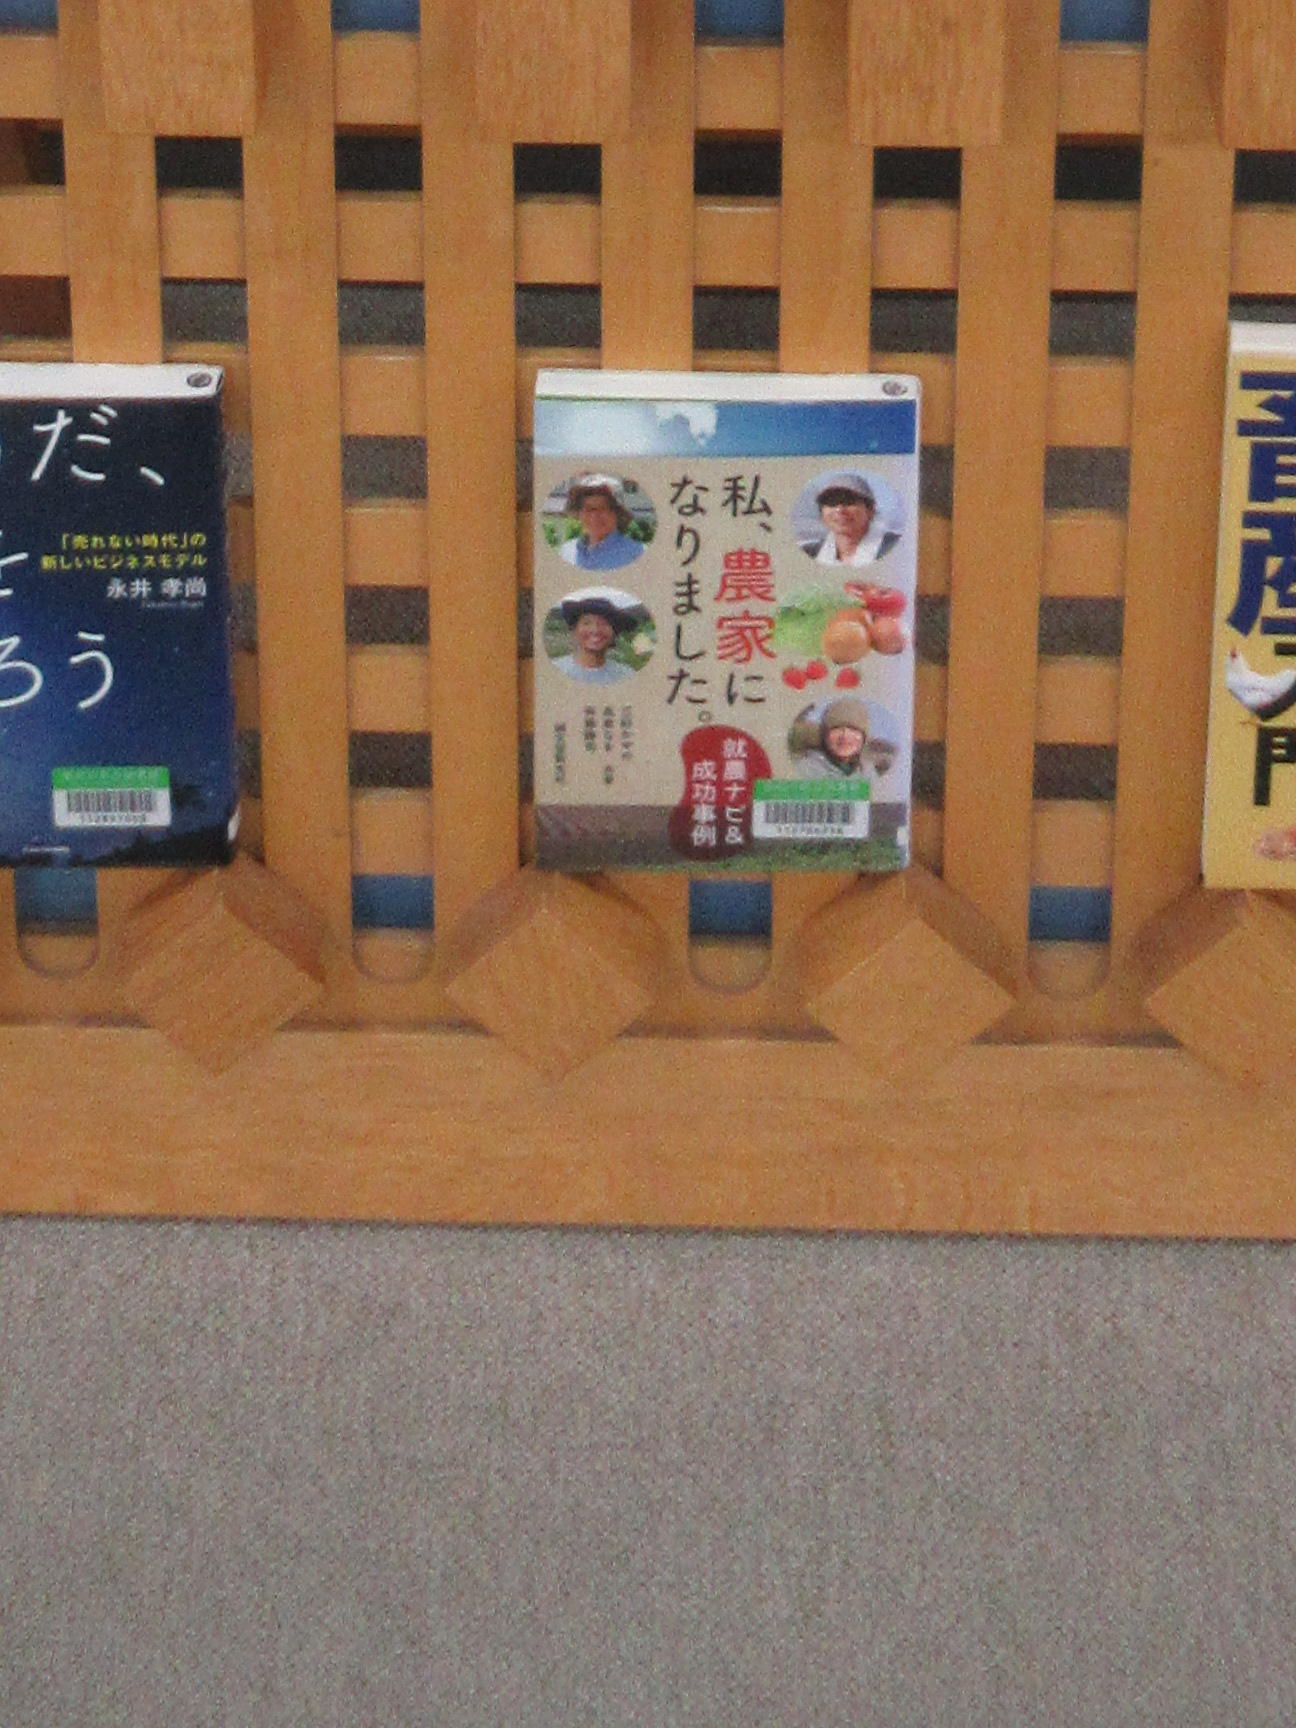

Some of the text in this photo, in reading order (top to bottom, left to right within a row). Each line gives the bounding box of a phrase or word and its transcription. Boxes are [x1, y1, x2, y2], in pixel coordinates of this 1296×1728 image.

[41, 553, 207, 570] 新しいビジネスモデル
[666, 475, 712, 723] なりました。
[691, 760, 717, 847] 成功事例
